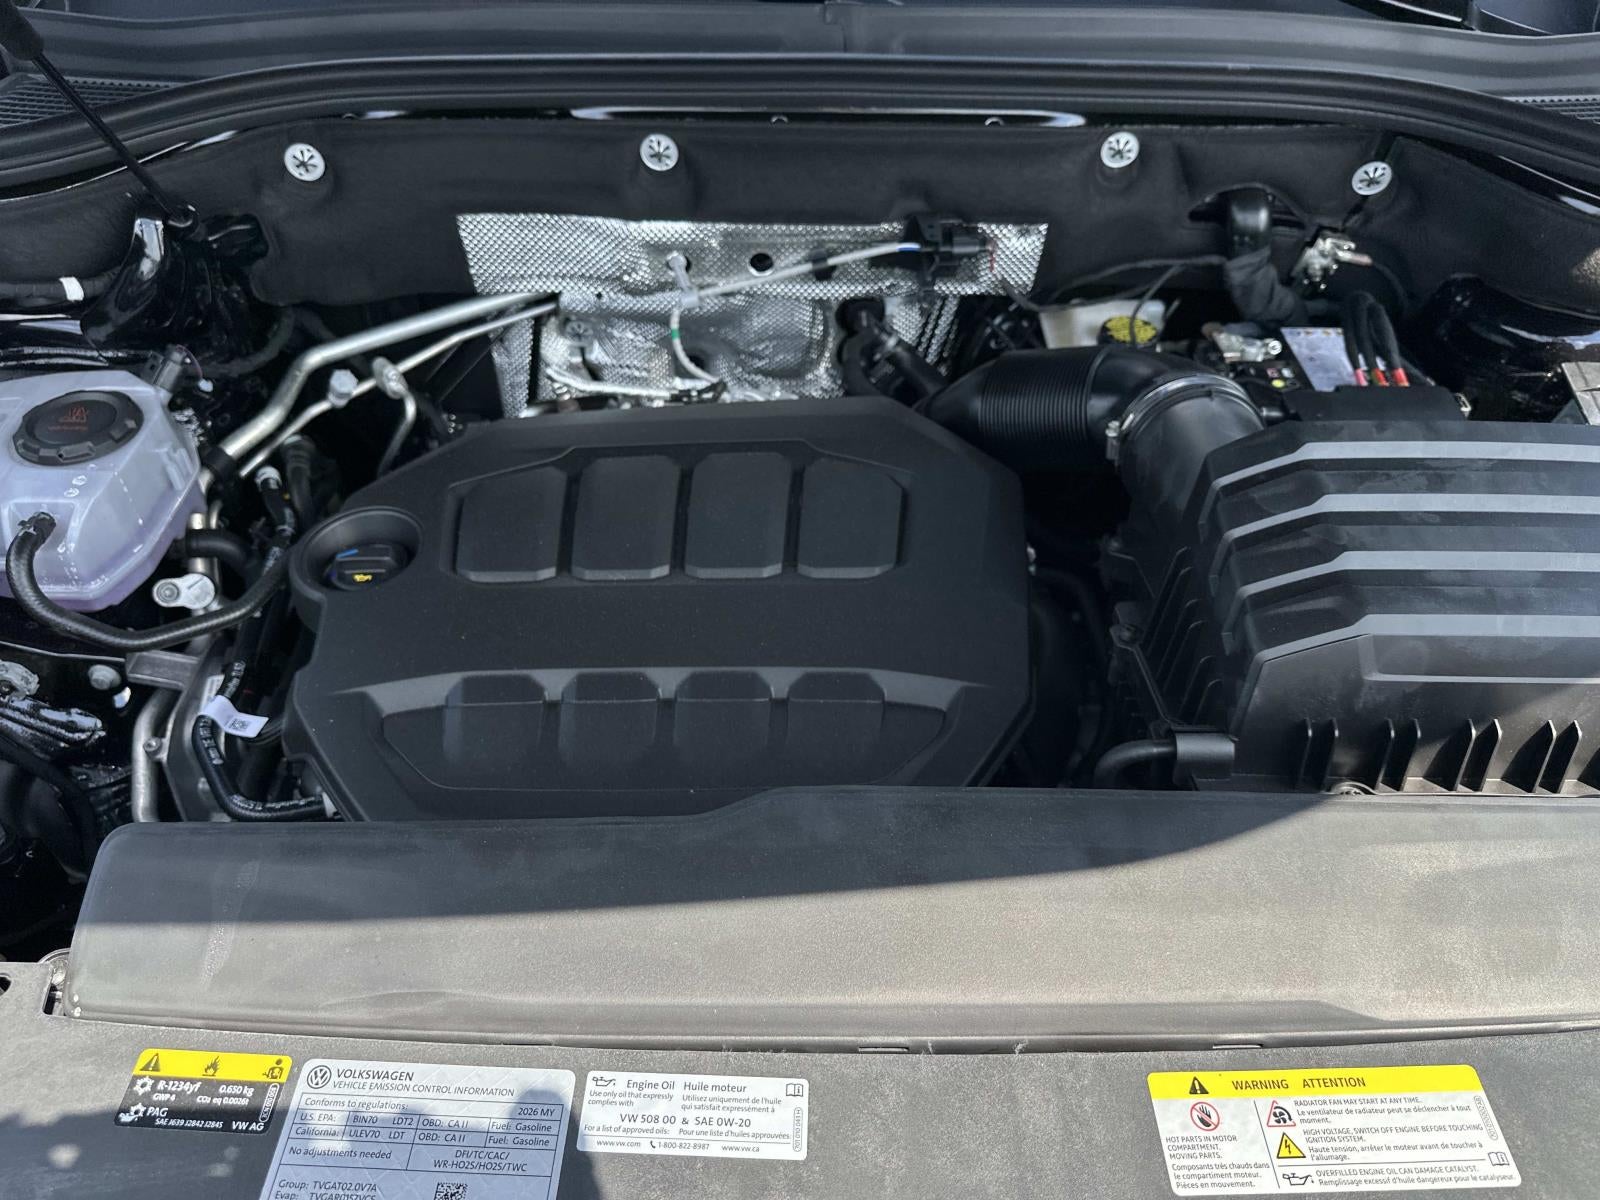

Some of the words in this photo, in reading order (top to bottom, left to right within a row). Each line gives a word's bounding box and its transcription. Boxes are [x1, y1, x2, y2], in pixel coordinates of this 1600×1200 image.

[337, 1069, 414, 1081] VOLKSWAGEN
[157, 1080, 201, 1093] R-1234yf
[219, 1085, 242, 1093] 0.650
[243, 1086, 254, 1095] kg
[627, 1080, 659, 1090] Engine
[662, 1081, 675, 1090] Oil
[684, 1082, 709, 1091] Huile
[1232, 1079, 1289, 1090] WARNING
[1303, 1077, 1366, 1088] ATTENTION
[333, 1081, 367, 1089] VEHICLE
[370, 1083, 410, 1091] EMISSION
[412, 1084, 452, 1094] CONTROL
[454, 1087, 515, 1096] INFORMATION
[153, 1093, 170, 1101] GWP
[682, 1094, 707, 1102] Utilisez
[709, 1096, 749, 1104] uniquement
[762, 1097, 781, 1105] l'huile
[304, 1098, 345, 1107] Conforms
[348, 1099, 356, 1107] to
[358, 1100, 408, 1110] regulations:
[588, 1099, 617, 1107] complies
[147, 1107, 168, 1116] PAG
[722, 1104, 769, 1113] expressément
[1413, 1105, 1449, 1113] déclencher
[300, 1113, 314, 1121] U.S.
[353, 1115, 378, 1123] BIN70
[392, 1116, 414, 1125] LDT2
[422, 1118, 443, 1127] OBD:
[491, 1122, 512, 1130] Fuel:
[516, 1123, 552, 1132] Gasoline
[620, 1114, 638, 1122] VW
[641, 1114, 659, 1123] 508
[662, 1116, 676, 1124] 00
[695, 1117, 713, 1125] SAE
[717, 1118, 751, 1127] 0W-20
[232, 1121, 247, 1129] VW
[249, 1122, 264, 1130] AG
[622, 1126, 654, 1134] approved
[1422, 1124, 1448, 1132] BEFORE
[296, 1127, 339, 1137] California:
[349, 1129, 380, 1138] ULEV70
[389, 1131, 405, 1139] LDT
[418, 1133, 440, 1142] OBD:
[488, 1136, 509, 1144] Fuel:
[513, 1137, 549, 1146] Gasoline
[658, 1141, 710, 1150] 1-800-822-8987
[1331, 1145, 1359, 1153] tension,
[289, 1147, 301, 1155] No
[304, 1148, 357, 1158] adjustments
[360, 1150, 392, 1159] needed
[455, 1150, 510, 1160] DFI/TC/CAC/
[1172, 1163, 1213, 1171] Composants
[1182, 1172, 1232, 1181] compartiment
[1319, 1179, 1362, 1187] Remplissage
[1392, 1175, 1415, 1183] d'huile
[1417, 1176, 1452, 1184] dangereux
[1454, 1175, 1470, 1183] pour
[278, 1179, 309, 1189] Group:
[313, 1181, 377, 1191] TVGAT02.0V7A
[275, 1191, 299, 1200] Evap:
